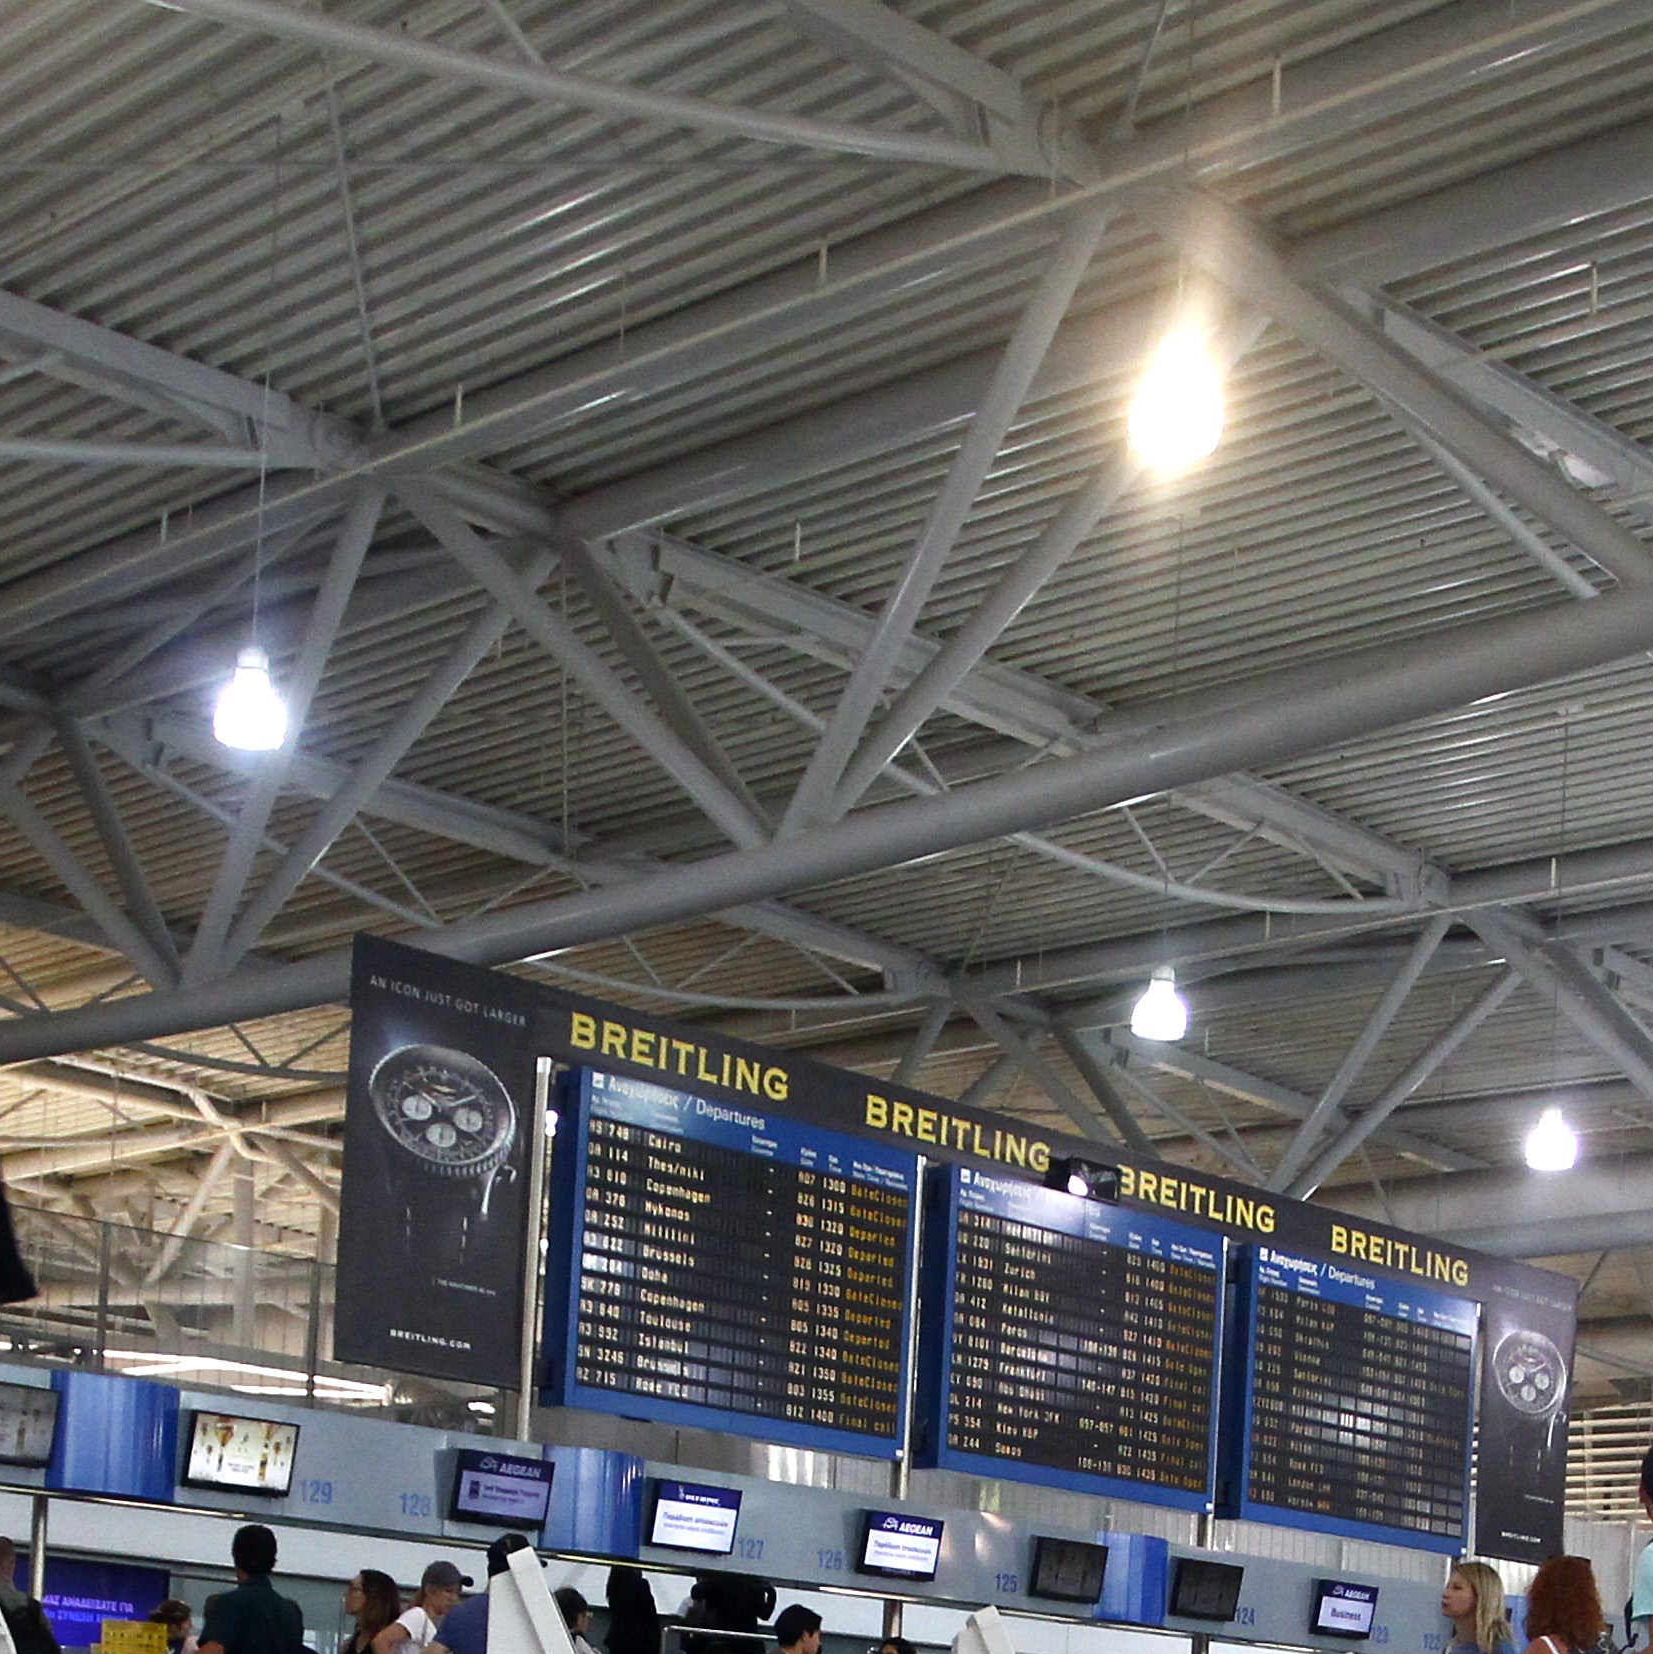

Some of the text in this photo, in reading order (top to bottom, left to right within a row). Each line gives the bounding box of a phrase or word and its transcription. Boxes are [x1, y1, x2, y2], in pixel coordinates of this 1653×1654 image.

[370, 975, 527, 1027] AN ICON JUST GOT LARGER
[570, 1011, 790, 1101] BREITLING
[696, 1099, 765, 1131] Departures
[648, 1133, 680, 1154] Cairo
[865, 1094, 1051, 1173] BREITLING
[646, 1177, 710, 1205] Copenhagen
[820, 1218, 843, 1235] 1320
[821, 1197, 845, 1214] 1315
[1117, 1164, 1277, 1234] BREITLING
[645, 1199, 690, 1222] Mykonos
[819, 1239, 842, 1256] 1320
[1330, 1224, 1469, 1287] BREITLING
[642, 1243, 694, 1266] Brussels
[817, 1281, 840, 1298] 1330
[818, 1260, 841, 1277] 1325
[1003, 1262, 1035, 1280] Zurich
[1328, 1265, 1375, 1291] Departures
[640, 1288, 704, 1313] Copenhagen
[814, 1324, 838, 1340] 1340
[816, 1303, 839, 1319] 1335
[390, 1328, 472, 1350] BREITLING.COM
[639, 1310, 690, 1332] Toulouse
[813, 1345, 837, 1361] 1340
[638, 1333, 689, 1355] Istanbul
[812, 1366, 835, 1382] 1350
[811, 1387, 834, 1402] 1355
[499, 1462, 542, 1478] AEGEAN
[301, 1480, 333, 1504] 129
[400, 1492, 431, 1517] 128
[898, 1521, 934, 1536] AEGEAN
[739, 1538, 764, 1560] 127
[994, 1573, 1017, 1593] 125
[1235, 1607, 1255, 1626] 124
[1331, 1607, 1362, 1622] Business
[1372, 1626, 1389, 1644] 123
[1423, 1633, 1441, 1651] 122
